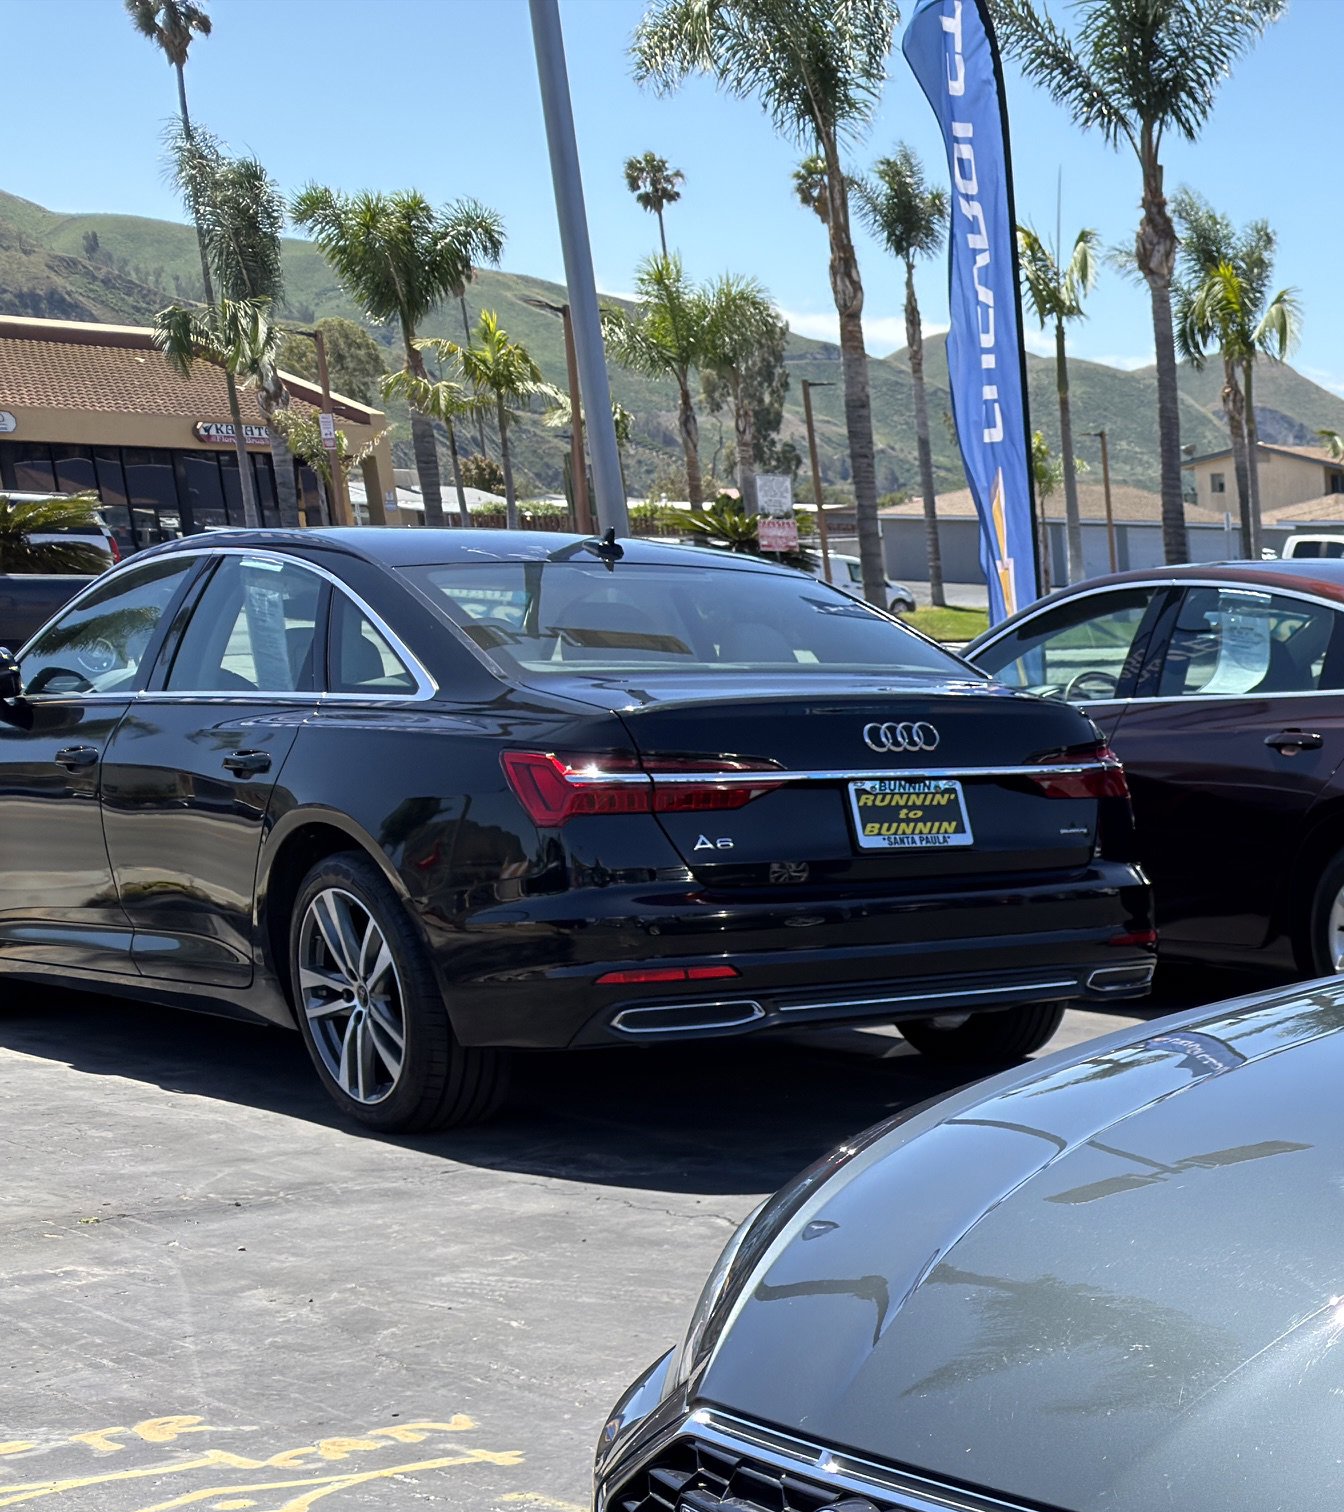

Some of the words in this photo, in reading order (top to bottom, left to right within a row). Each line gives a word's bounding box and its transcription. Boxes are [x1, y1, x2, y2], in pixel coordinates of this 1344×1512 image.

[215, 424, 269, 437] KAAT
[878, 781, 932, 793] BUNNIN
[858, 794, 956, 807] RUNNIN'
[899, 808, 924, 819] to
[864, 821, 957, 836] BUNNIN
[693, 834, 734, 851] A6
